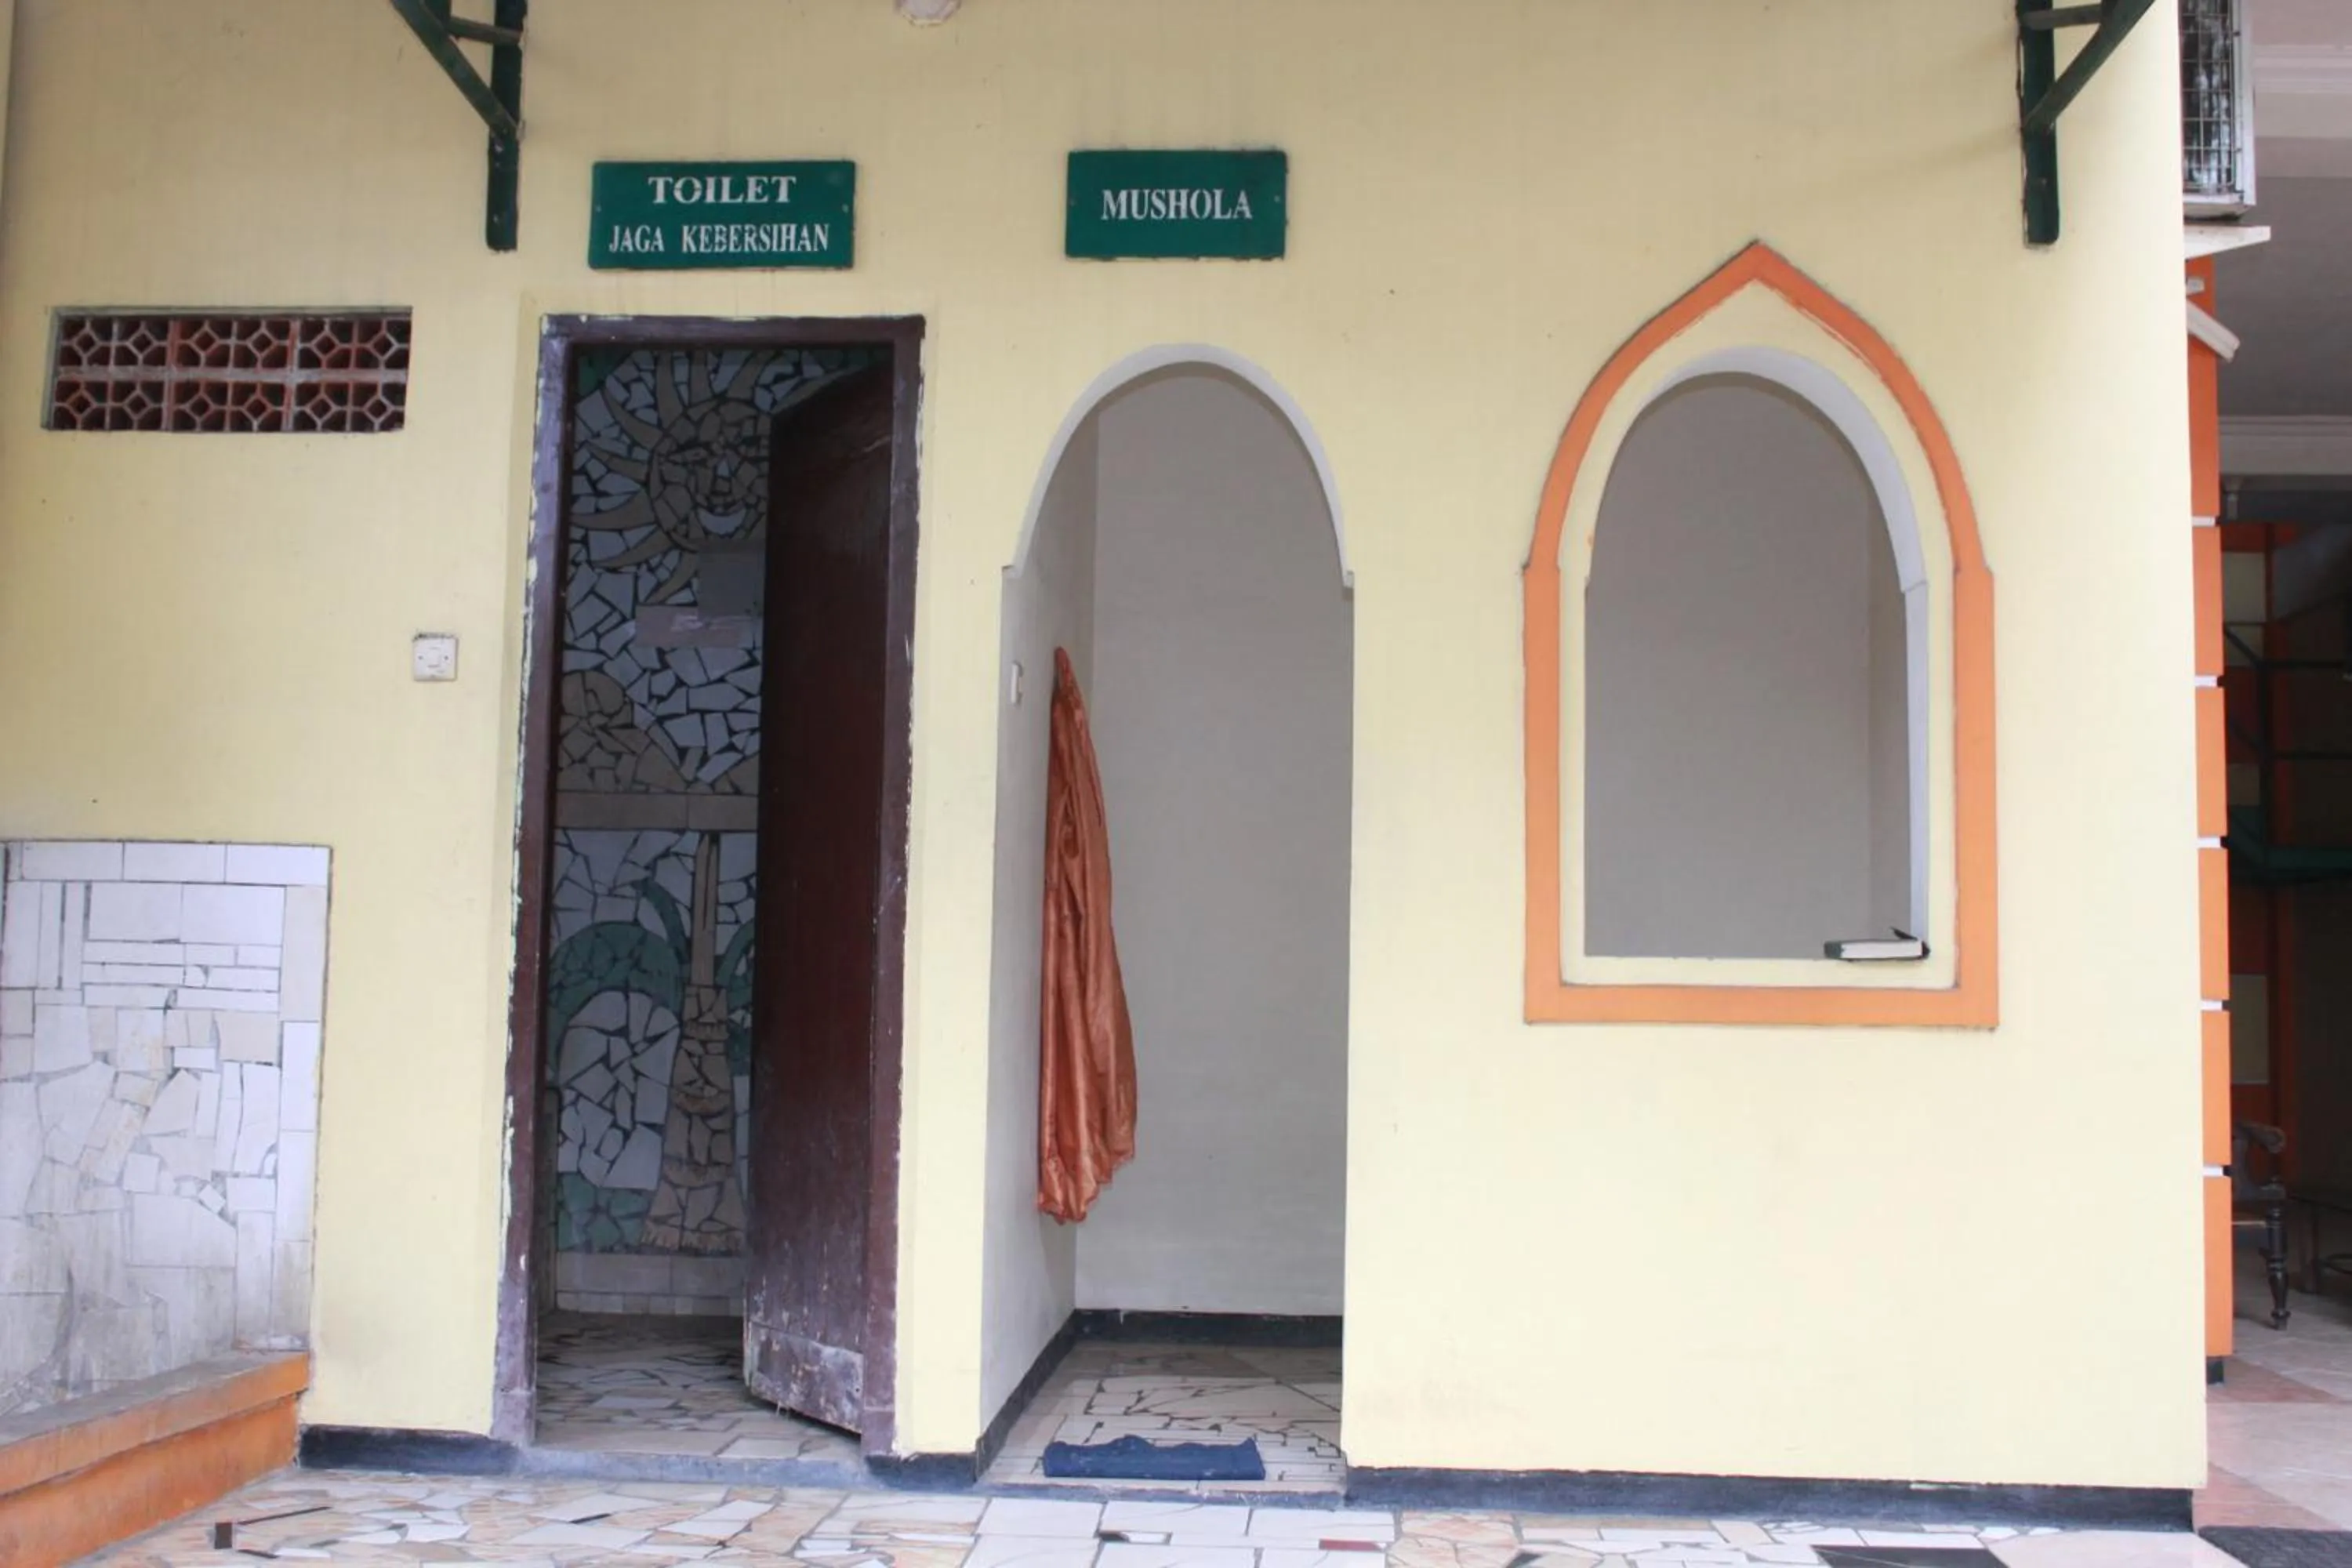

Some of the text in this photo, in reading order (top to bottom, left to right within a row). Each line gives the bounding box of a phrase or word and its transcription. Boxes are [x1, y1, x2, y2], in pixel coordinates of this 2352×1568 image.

[648, 176, 797, 204] TOILET
[1101, 188, 1253, 220] MUSHOLA
[608, 223, 829, 253] JAGA KEBERSIHAN
